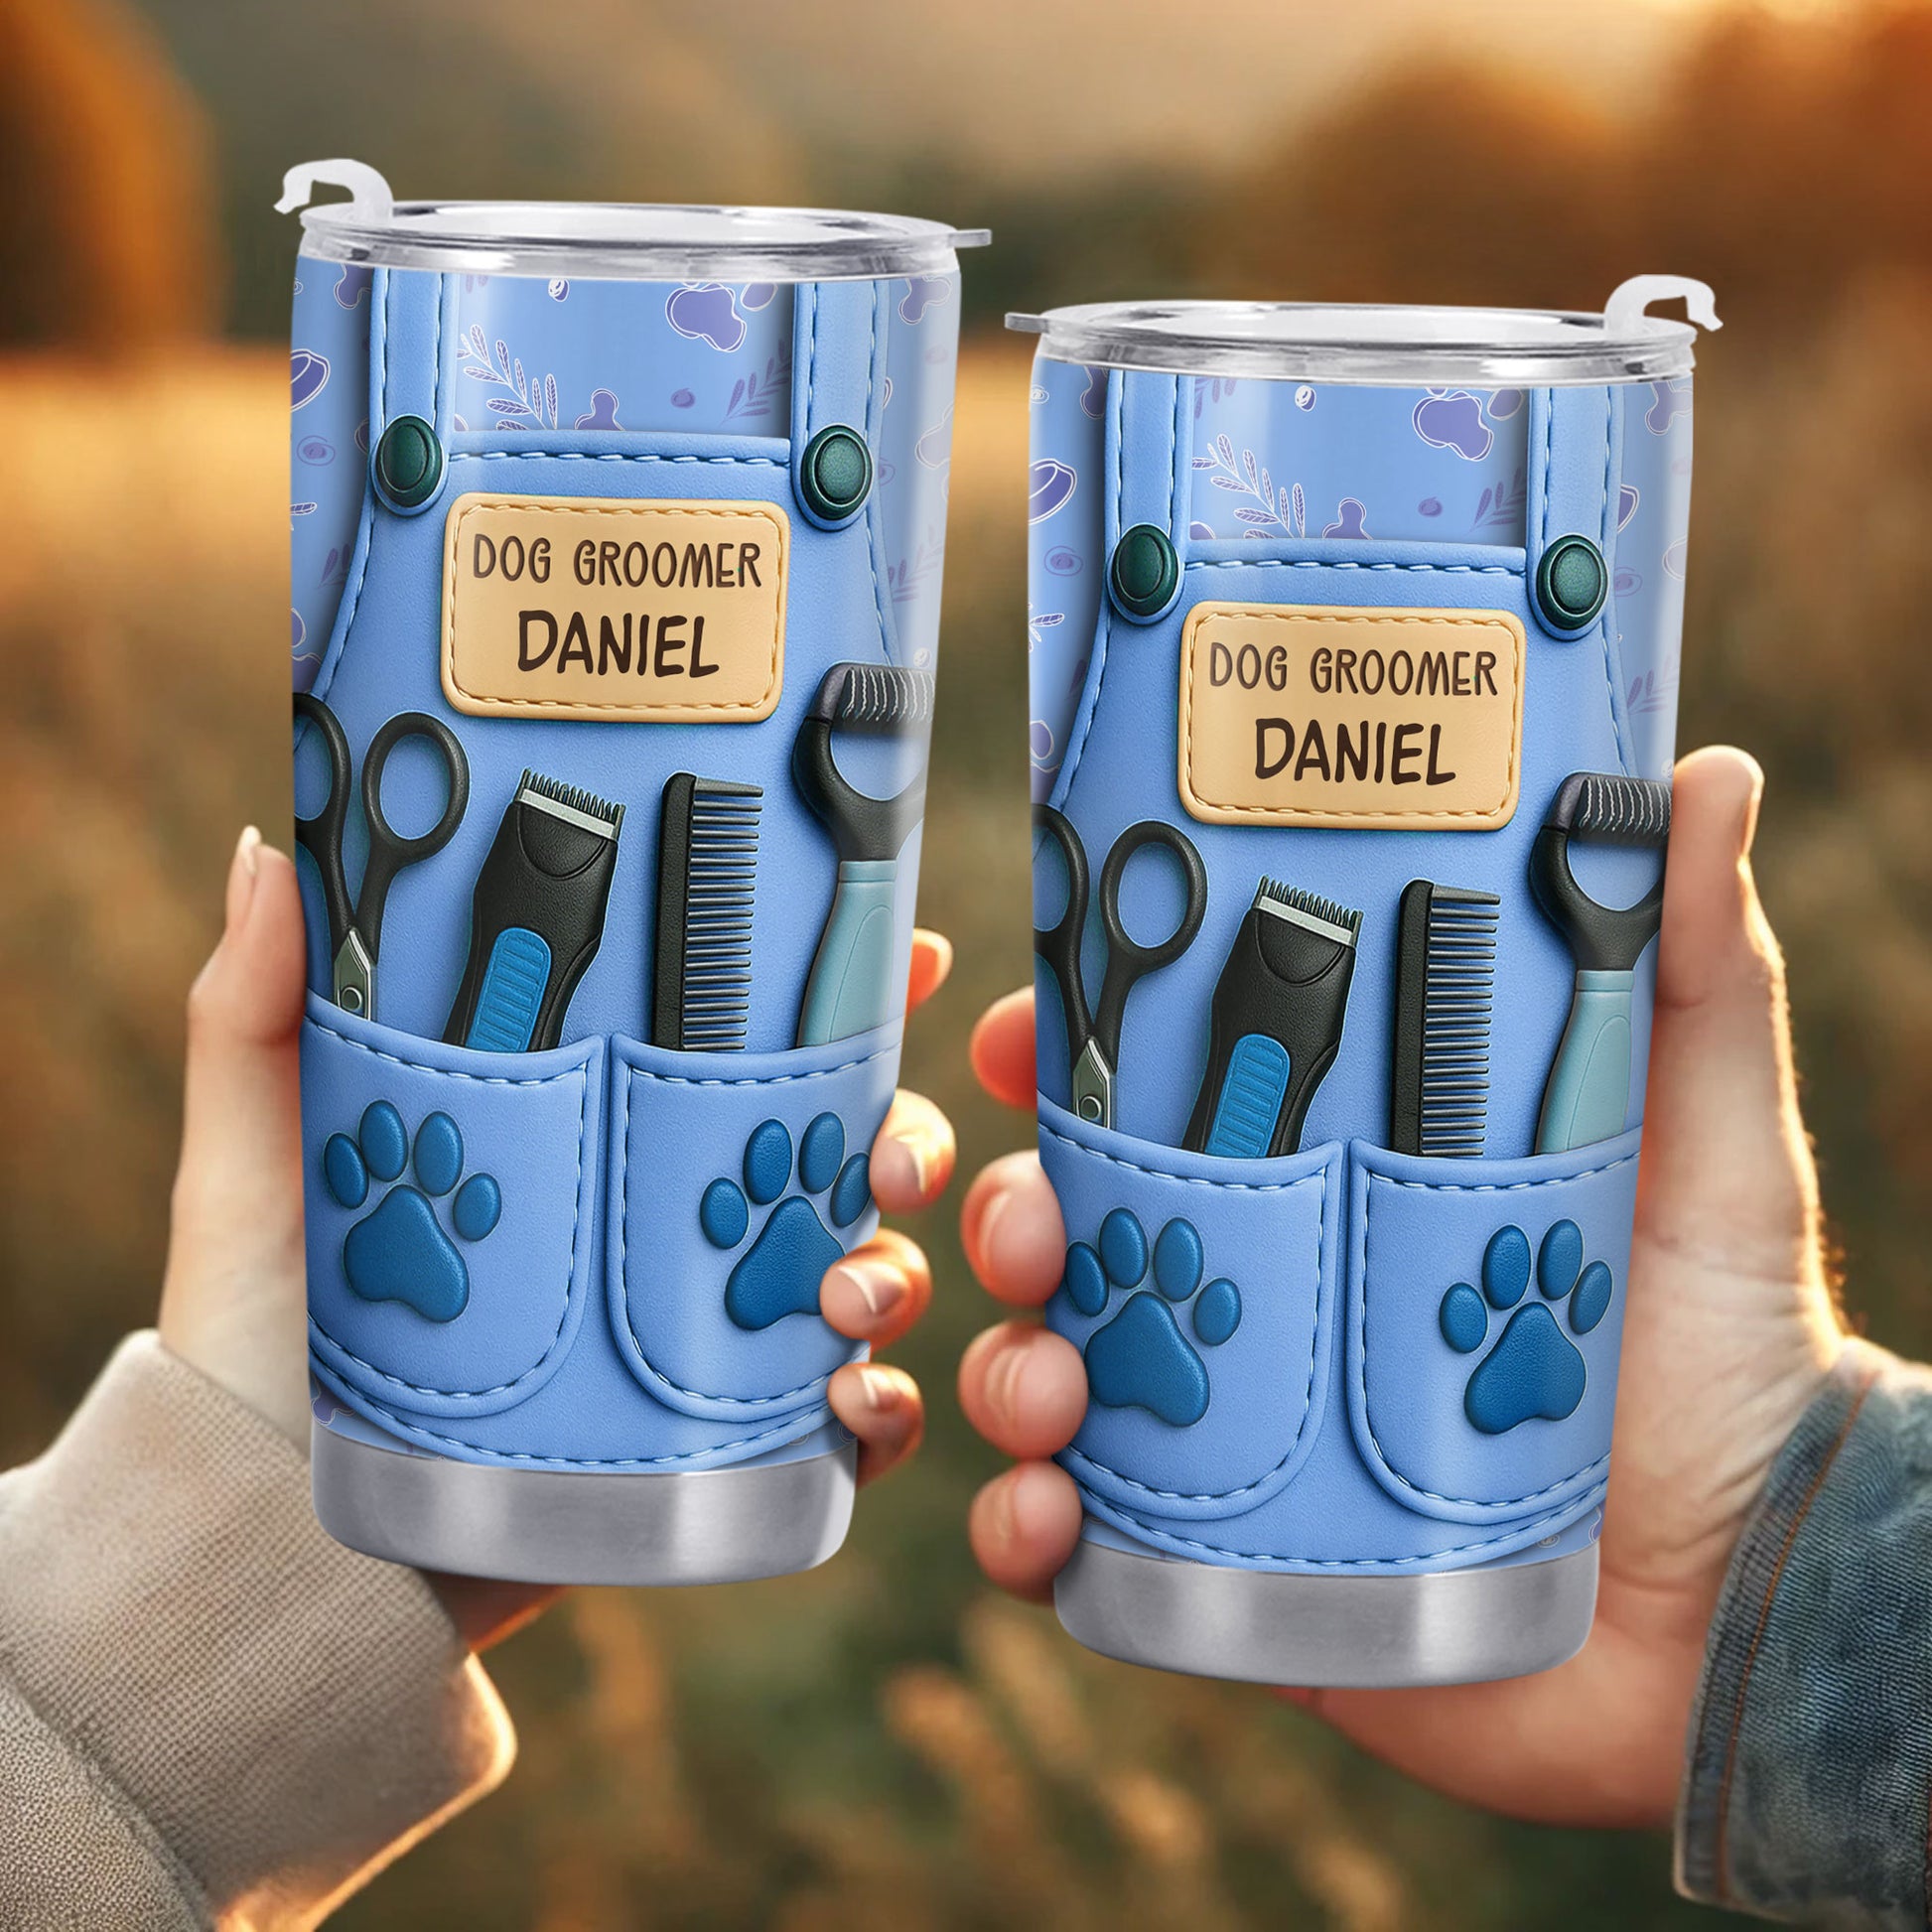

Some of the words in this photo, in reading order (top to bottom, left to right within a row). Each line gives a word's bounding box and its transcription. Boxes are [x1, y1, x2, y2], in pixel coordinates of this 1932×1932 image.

[474, 533, 551, 584] DOG
[573, 539, 762, 588] GROOMER
[517, 610, 720, 679] DANIEL
[1209, 641, 1288, 692] DOG
[1310, 646, 1498, 696] GROOMER
[1254, 717, 1456, 786] DANIEL
